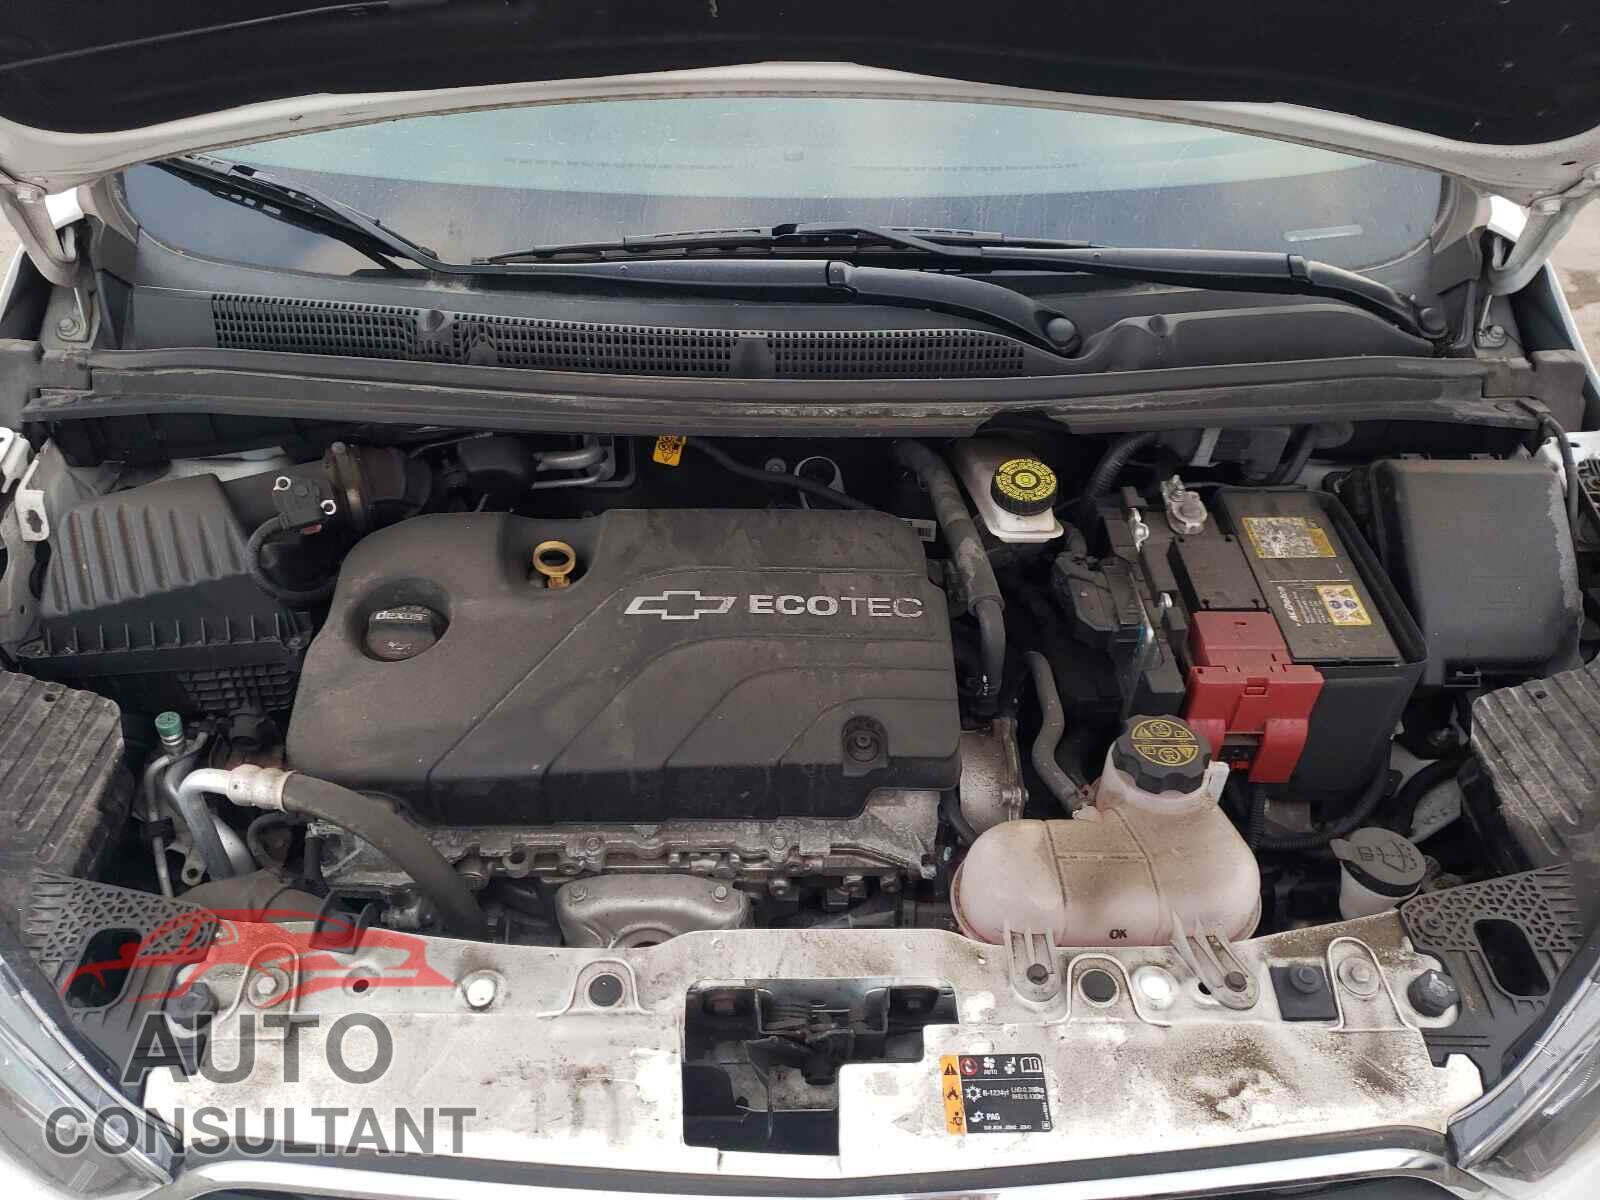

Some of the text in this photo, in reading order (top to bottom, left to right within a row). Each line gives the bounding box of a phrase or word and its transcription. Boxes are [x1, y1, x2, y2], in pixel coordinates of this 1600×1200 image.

[749, 594, 923, 618] ECOTEC
[1109, 928, 1128, 940] OK
[986, 1112, 1001, 1121] PAG
